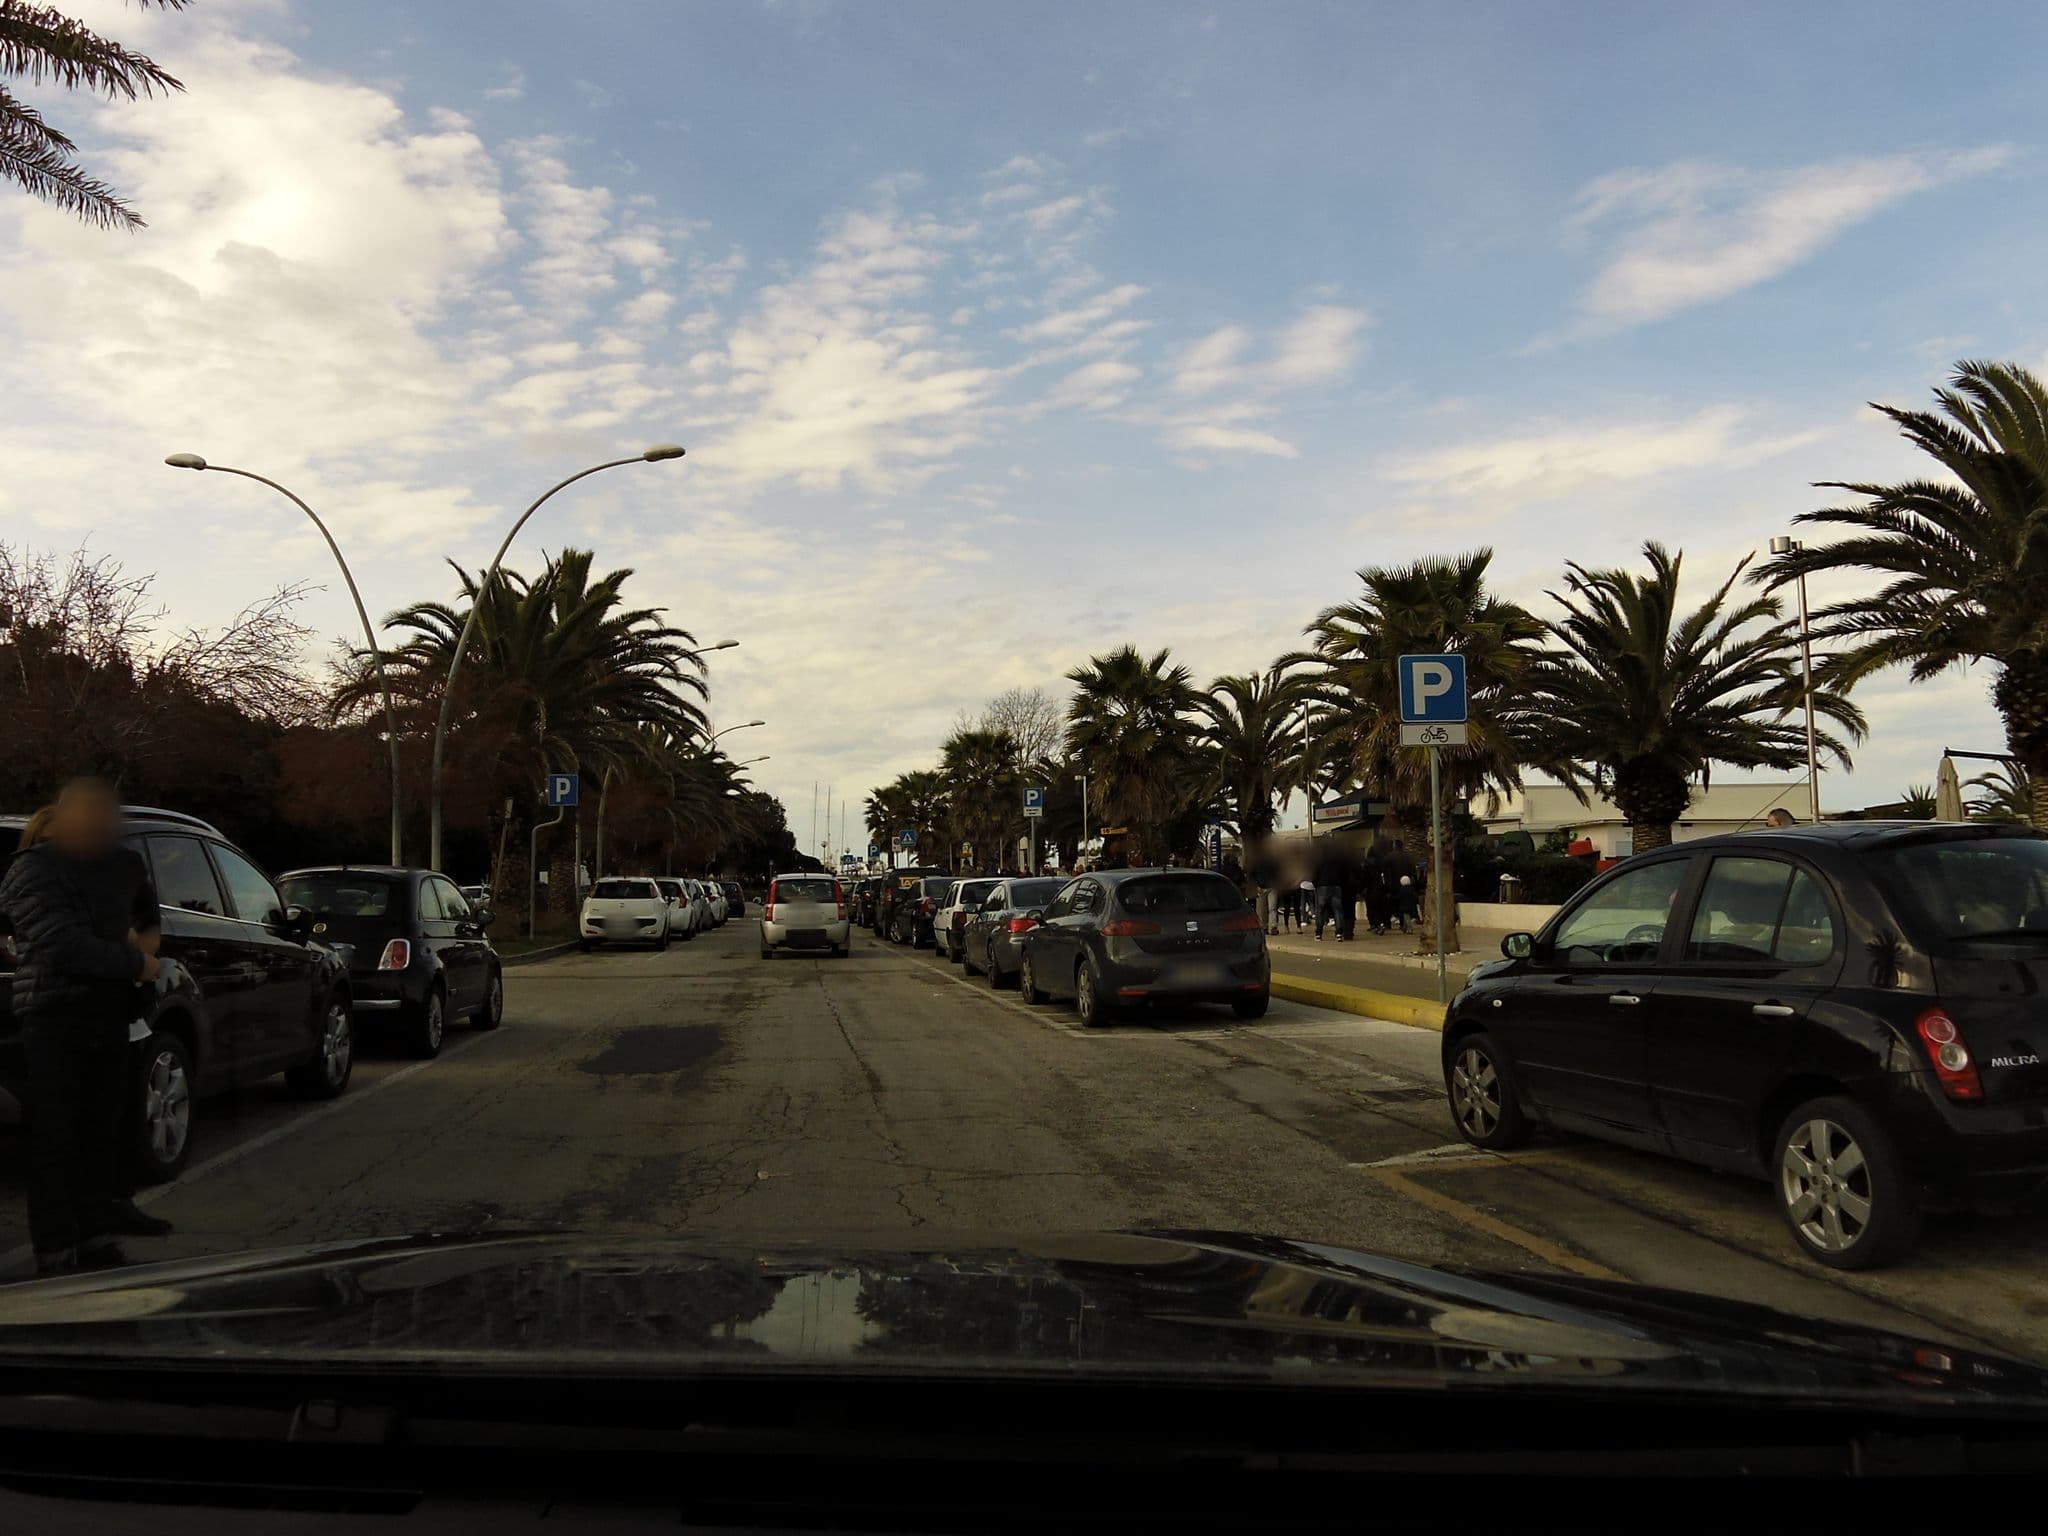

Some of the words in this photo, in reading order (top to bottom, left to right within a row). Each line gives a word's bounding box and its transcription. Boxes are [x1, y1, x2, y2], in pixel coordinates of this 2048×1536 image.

[1412, 661, 1453, 715] P
[556, 777, 571, 803] P
[1026, 790, 1039, 806] P
[870, 845, 878, 856] P
[1991, 1054, 2040, 1068] MICRA
